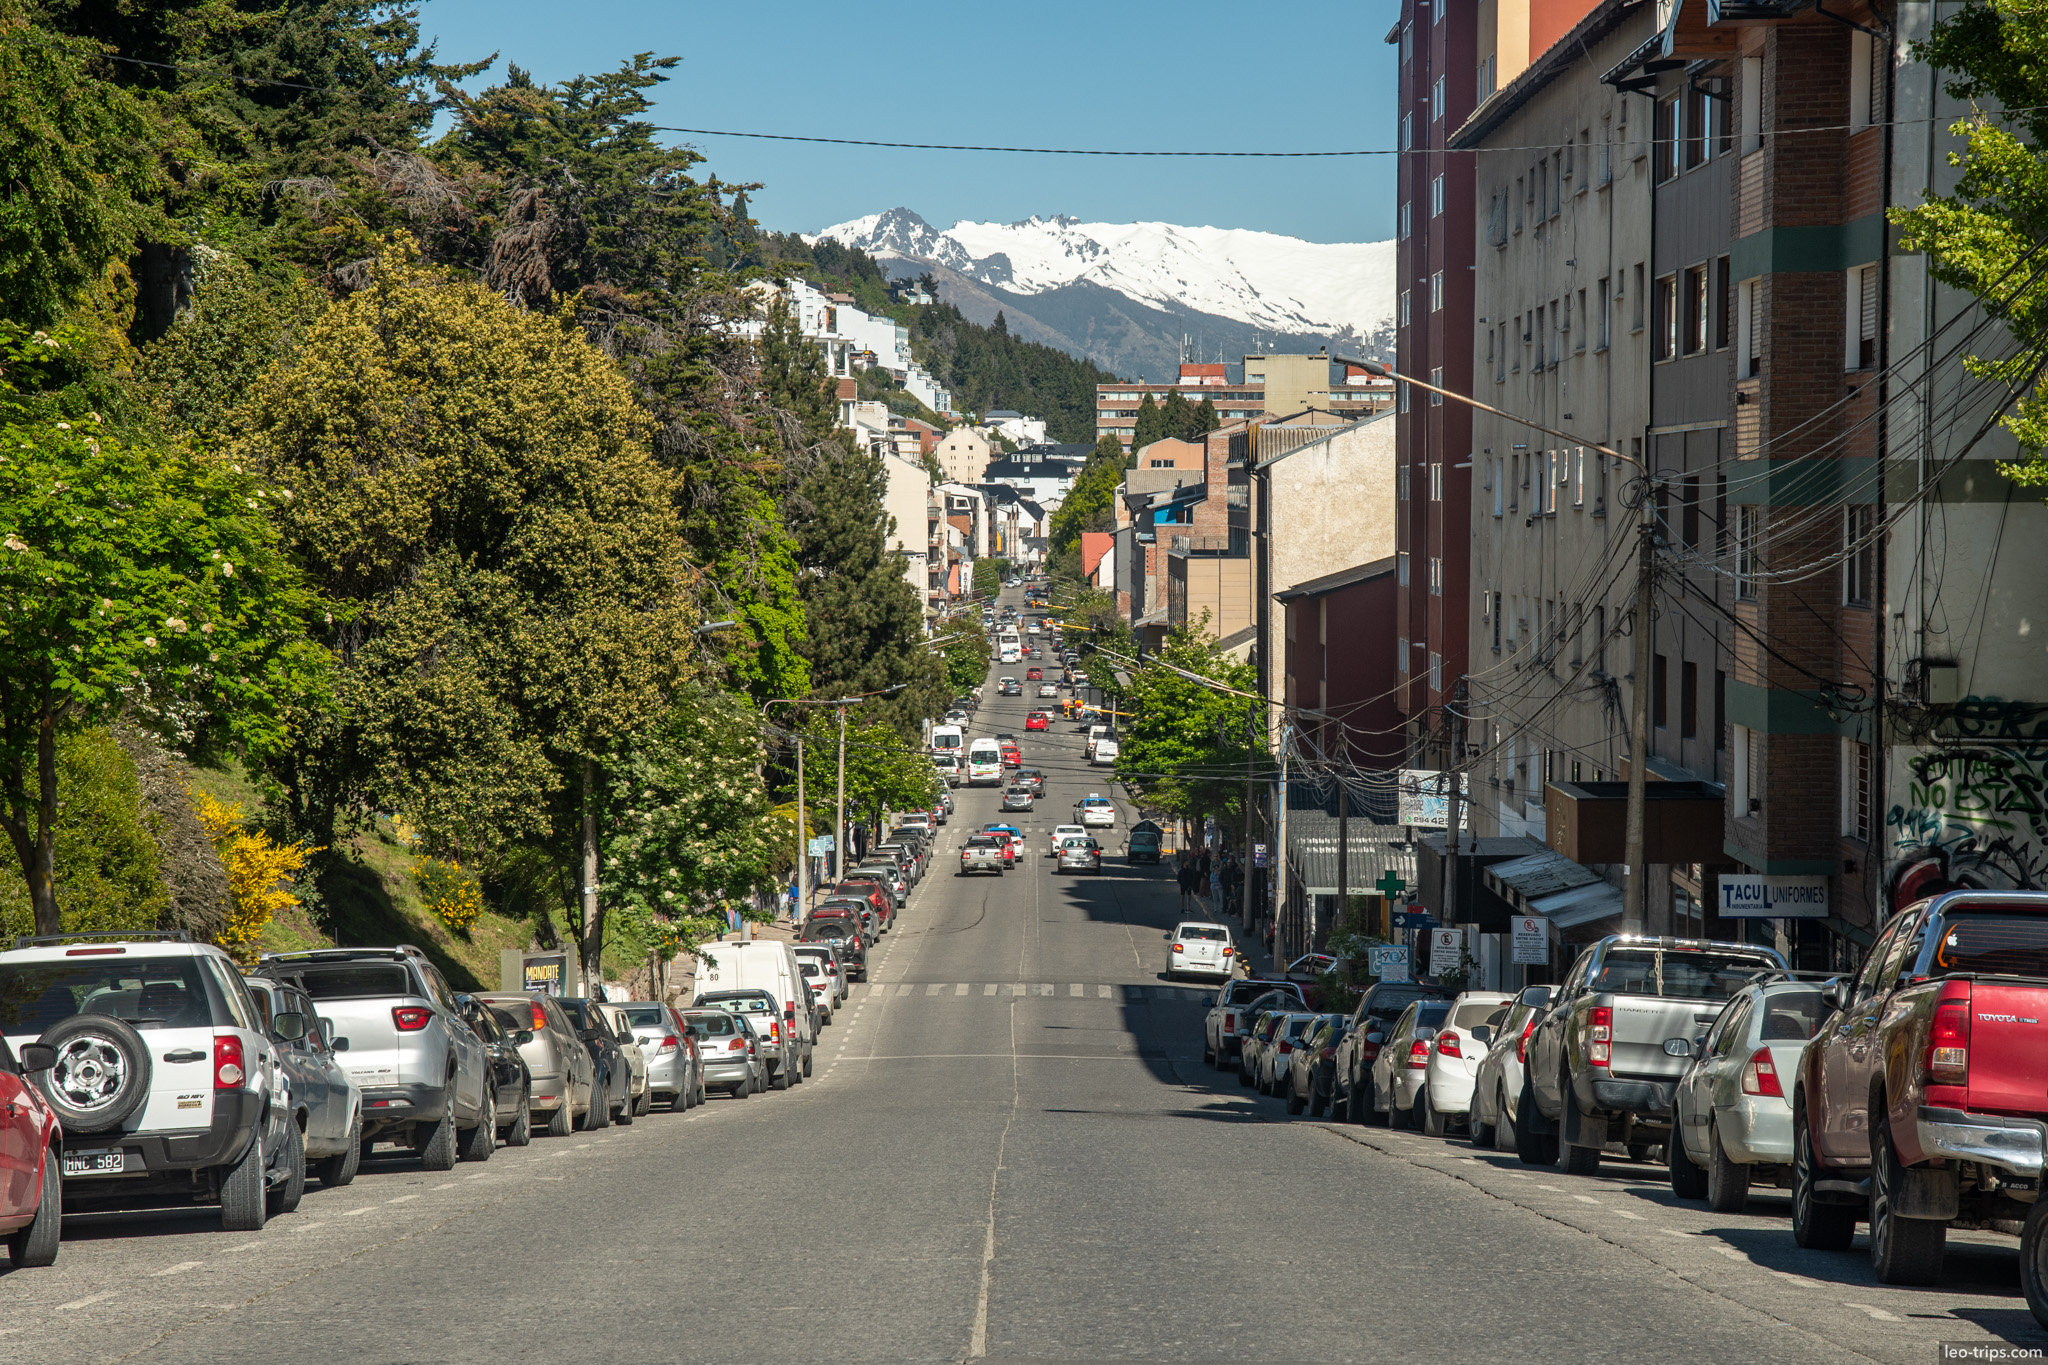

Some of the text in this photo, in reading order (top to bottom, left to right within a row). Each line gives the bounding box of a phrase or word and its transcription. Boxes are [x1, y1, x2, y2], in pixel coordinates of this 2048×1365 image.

[1910, 782, 1947, 809] NO
[1722, 884, 1825, 909] TACUL UNIFORMES
[526, 964, 560, 980] MANDATE
[1978, 1013, 2016, 1022] TOYOTA
[65, 1154, 122, 1172] HNC 582
